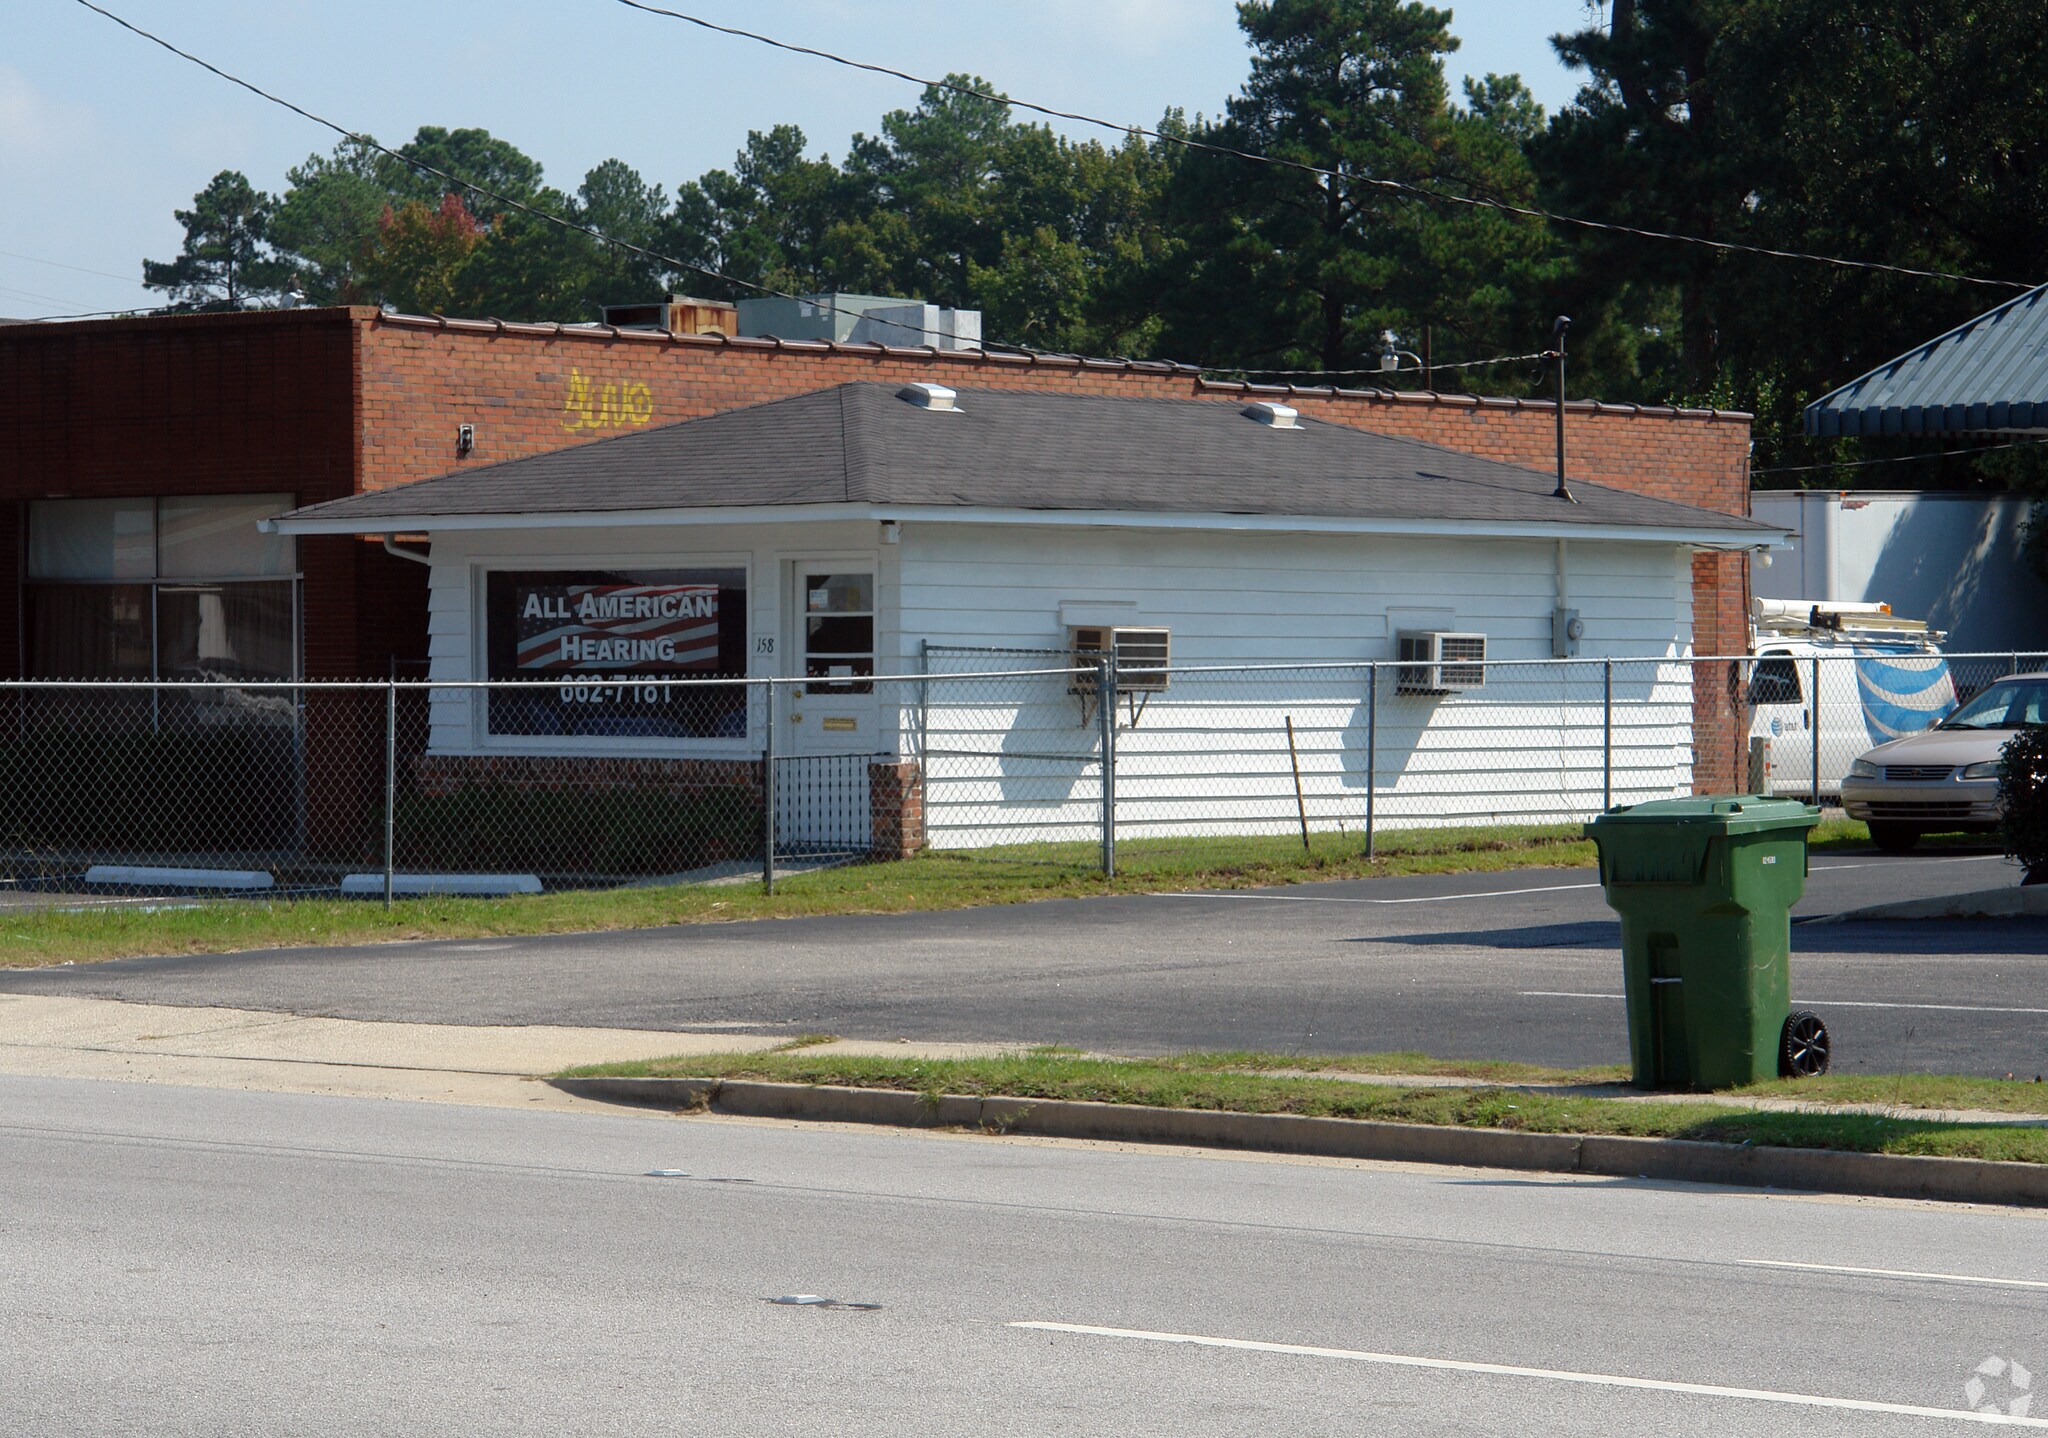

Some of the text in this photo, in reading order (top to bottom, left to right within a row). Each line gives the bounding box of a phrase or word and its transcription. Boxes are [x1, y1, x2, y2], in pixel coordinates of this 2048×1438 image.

[523, 592, 713, 619] ALL AMERICAN
[560, 635, 675, 661] HEARING
[757, 637, 774, 653] 158
